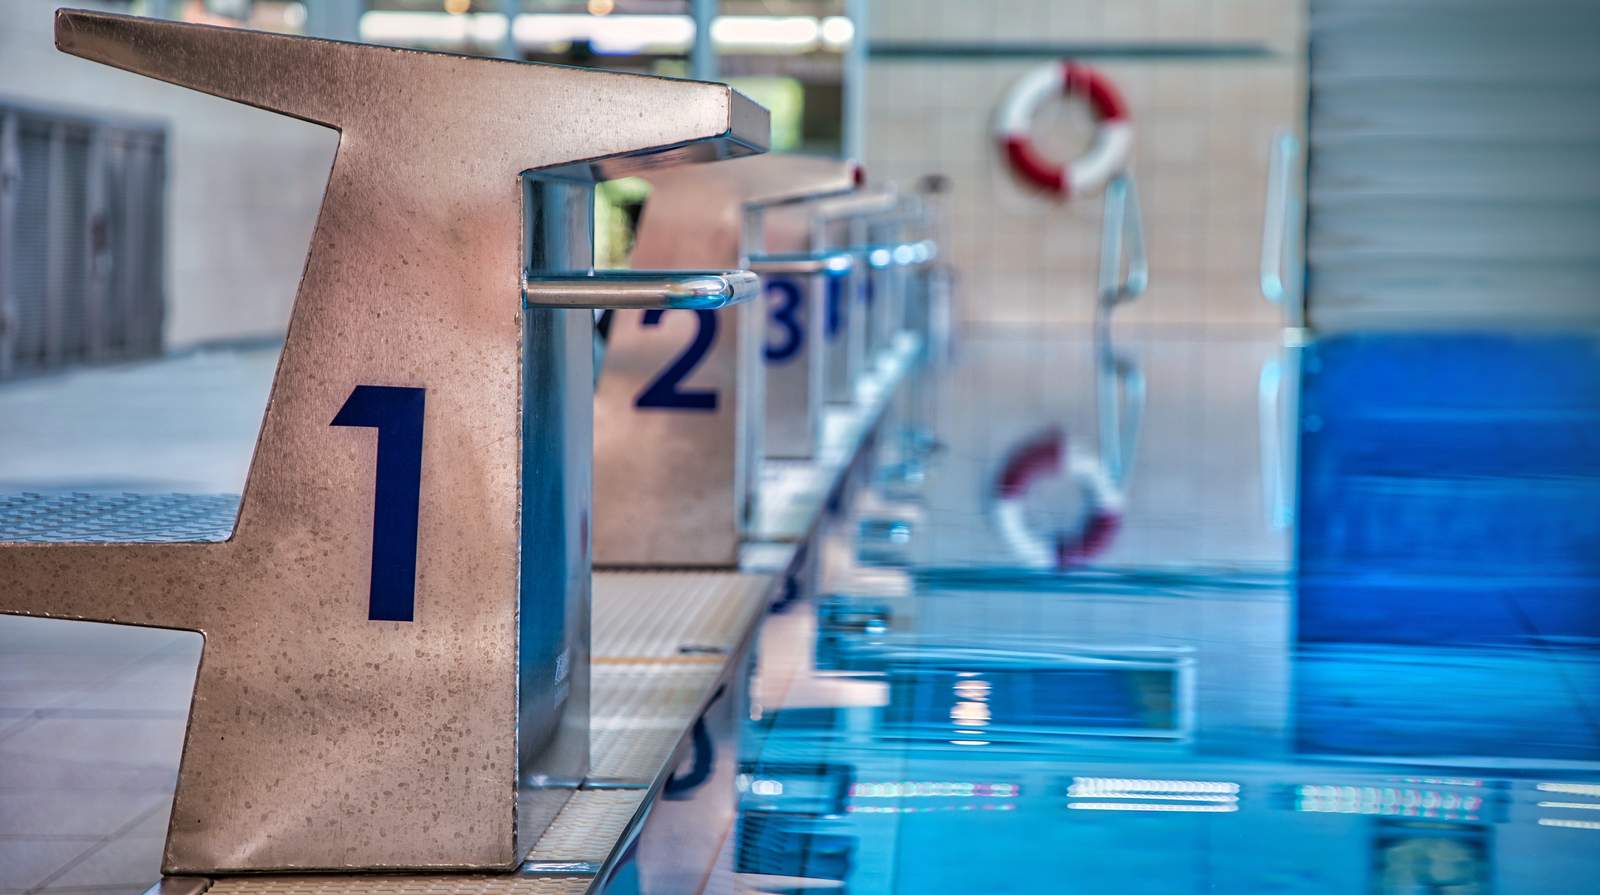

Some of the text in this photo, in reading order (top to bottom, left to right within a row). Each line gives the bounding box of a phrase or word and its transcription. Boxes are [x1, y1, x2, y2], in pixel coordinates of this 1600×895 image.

[634, 309, 719, 411] 2
[762, 279, 805, 364] 3
[329, 385, 426, 622] 1
